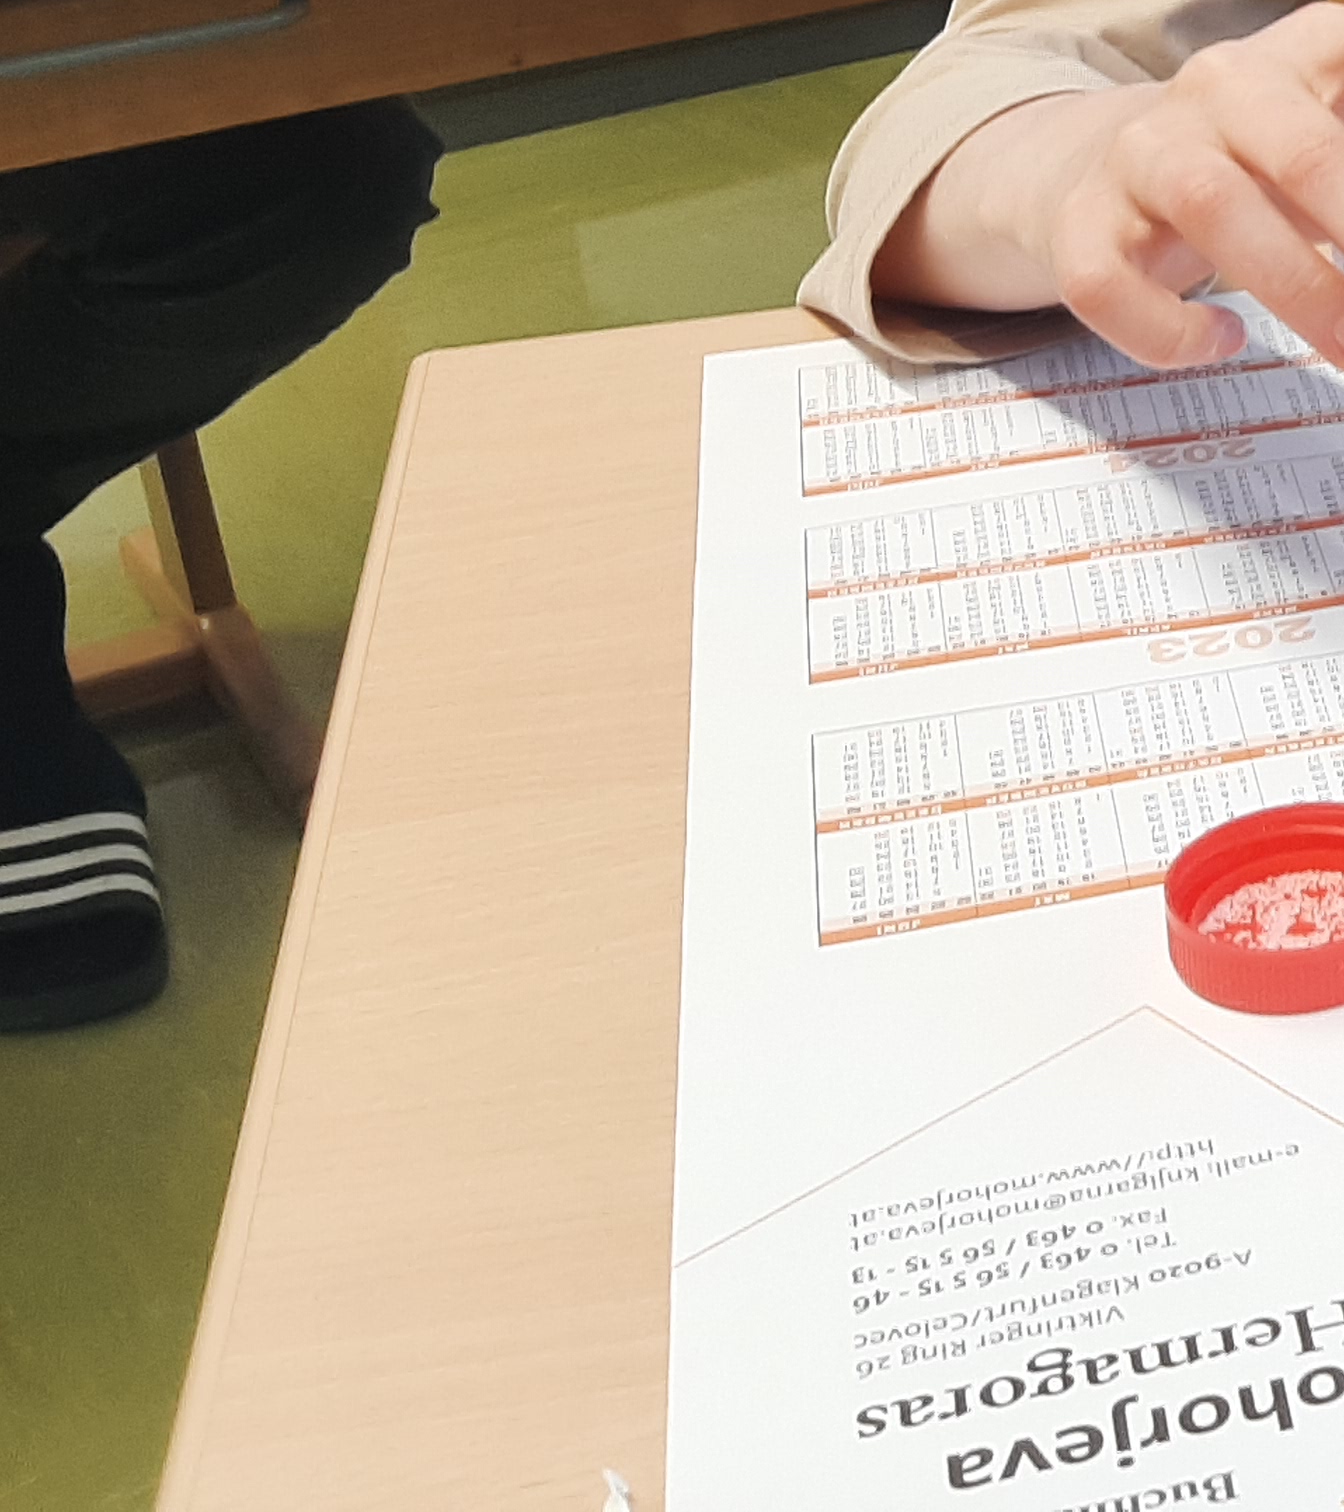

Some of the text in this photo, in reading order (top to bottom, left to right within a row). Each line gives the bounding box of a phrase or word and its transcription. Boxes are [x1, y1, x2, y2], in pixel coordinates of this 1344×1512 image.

[1147, 617, 1315, 664] 2023
[962, 1239, 996, 1264] 56
[975, 1262, 1010, 1288] 56
[855, 1305, 1125, 1378] Viktringer Ring 26
